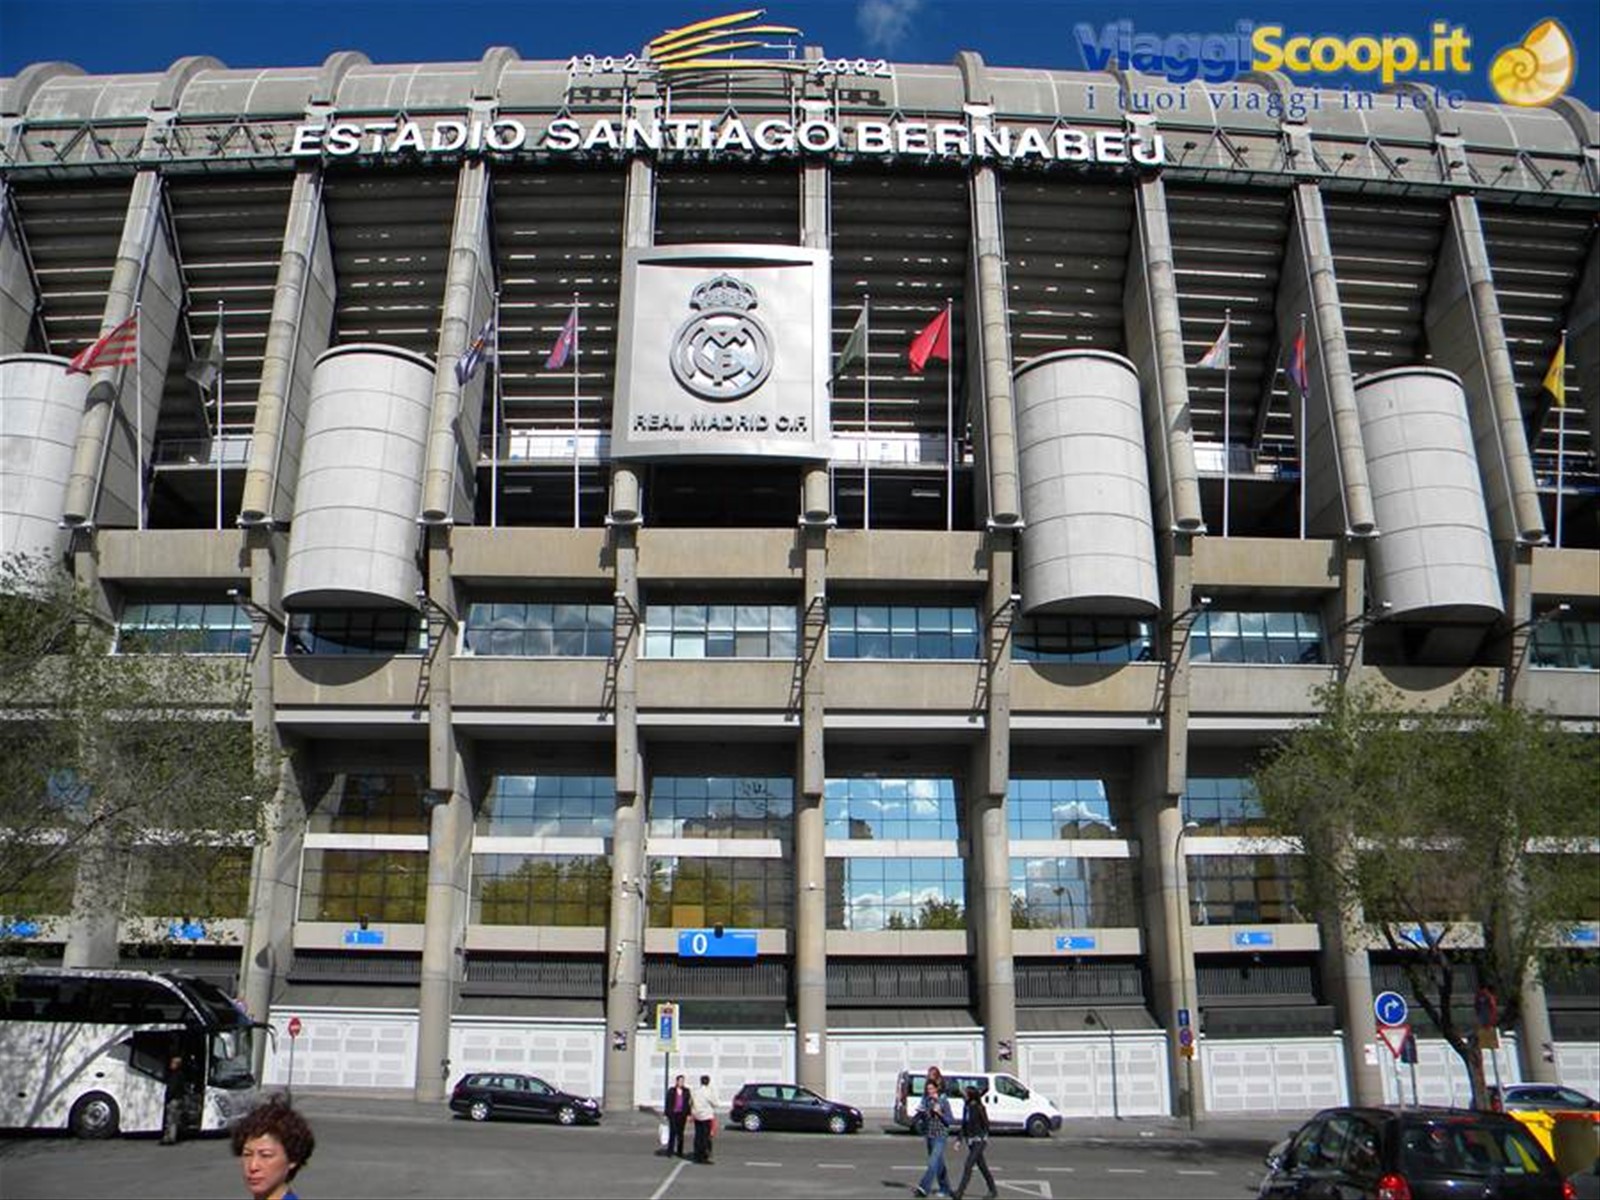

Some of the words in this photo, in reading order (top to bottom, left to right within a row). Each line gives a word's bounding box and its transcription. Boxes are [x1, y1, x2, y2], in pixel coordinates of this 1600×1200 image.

[566, 53, 639, 73] 1902
[816, 58, 893, 77] 2002
[290, 118, 528, 157] ESTADIO
[546, 117, 840, 153] SANTIAGO
[856, 120, 1167, 166] BERNABEU
[633, 414, 684, 432] REAL
[690, 414, 769, 432] MADRID
[692, 933, 708, 955] 0
